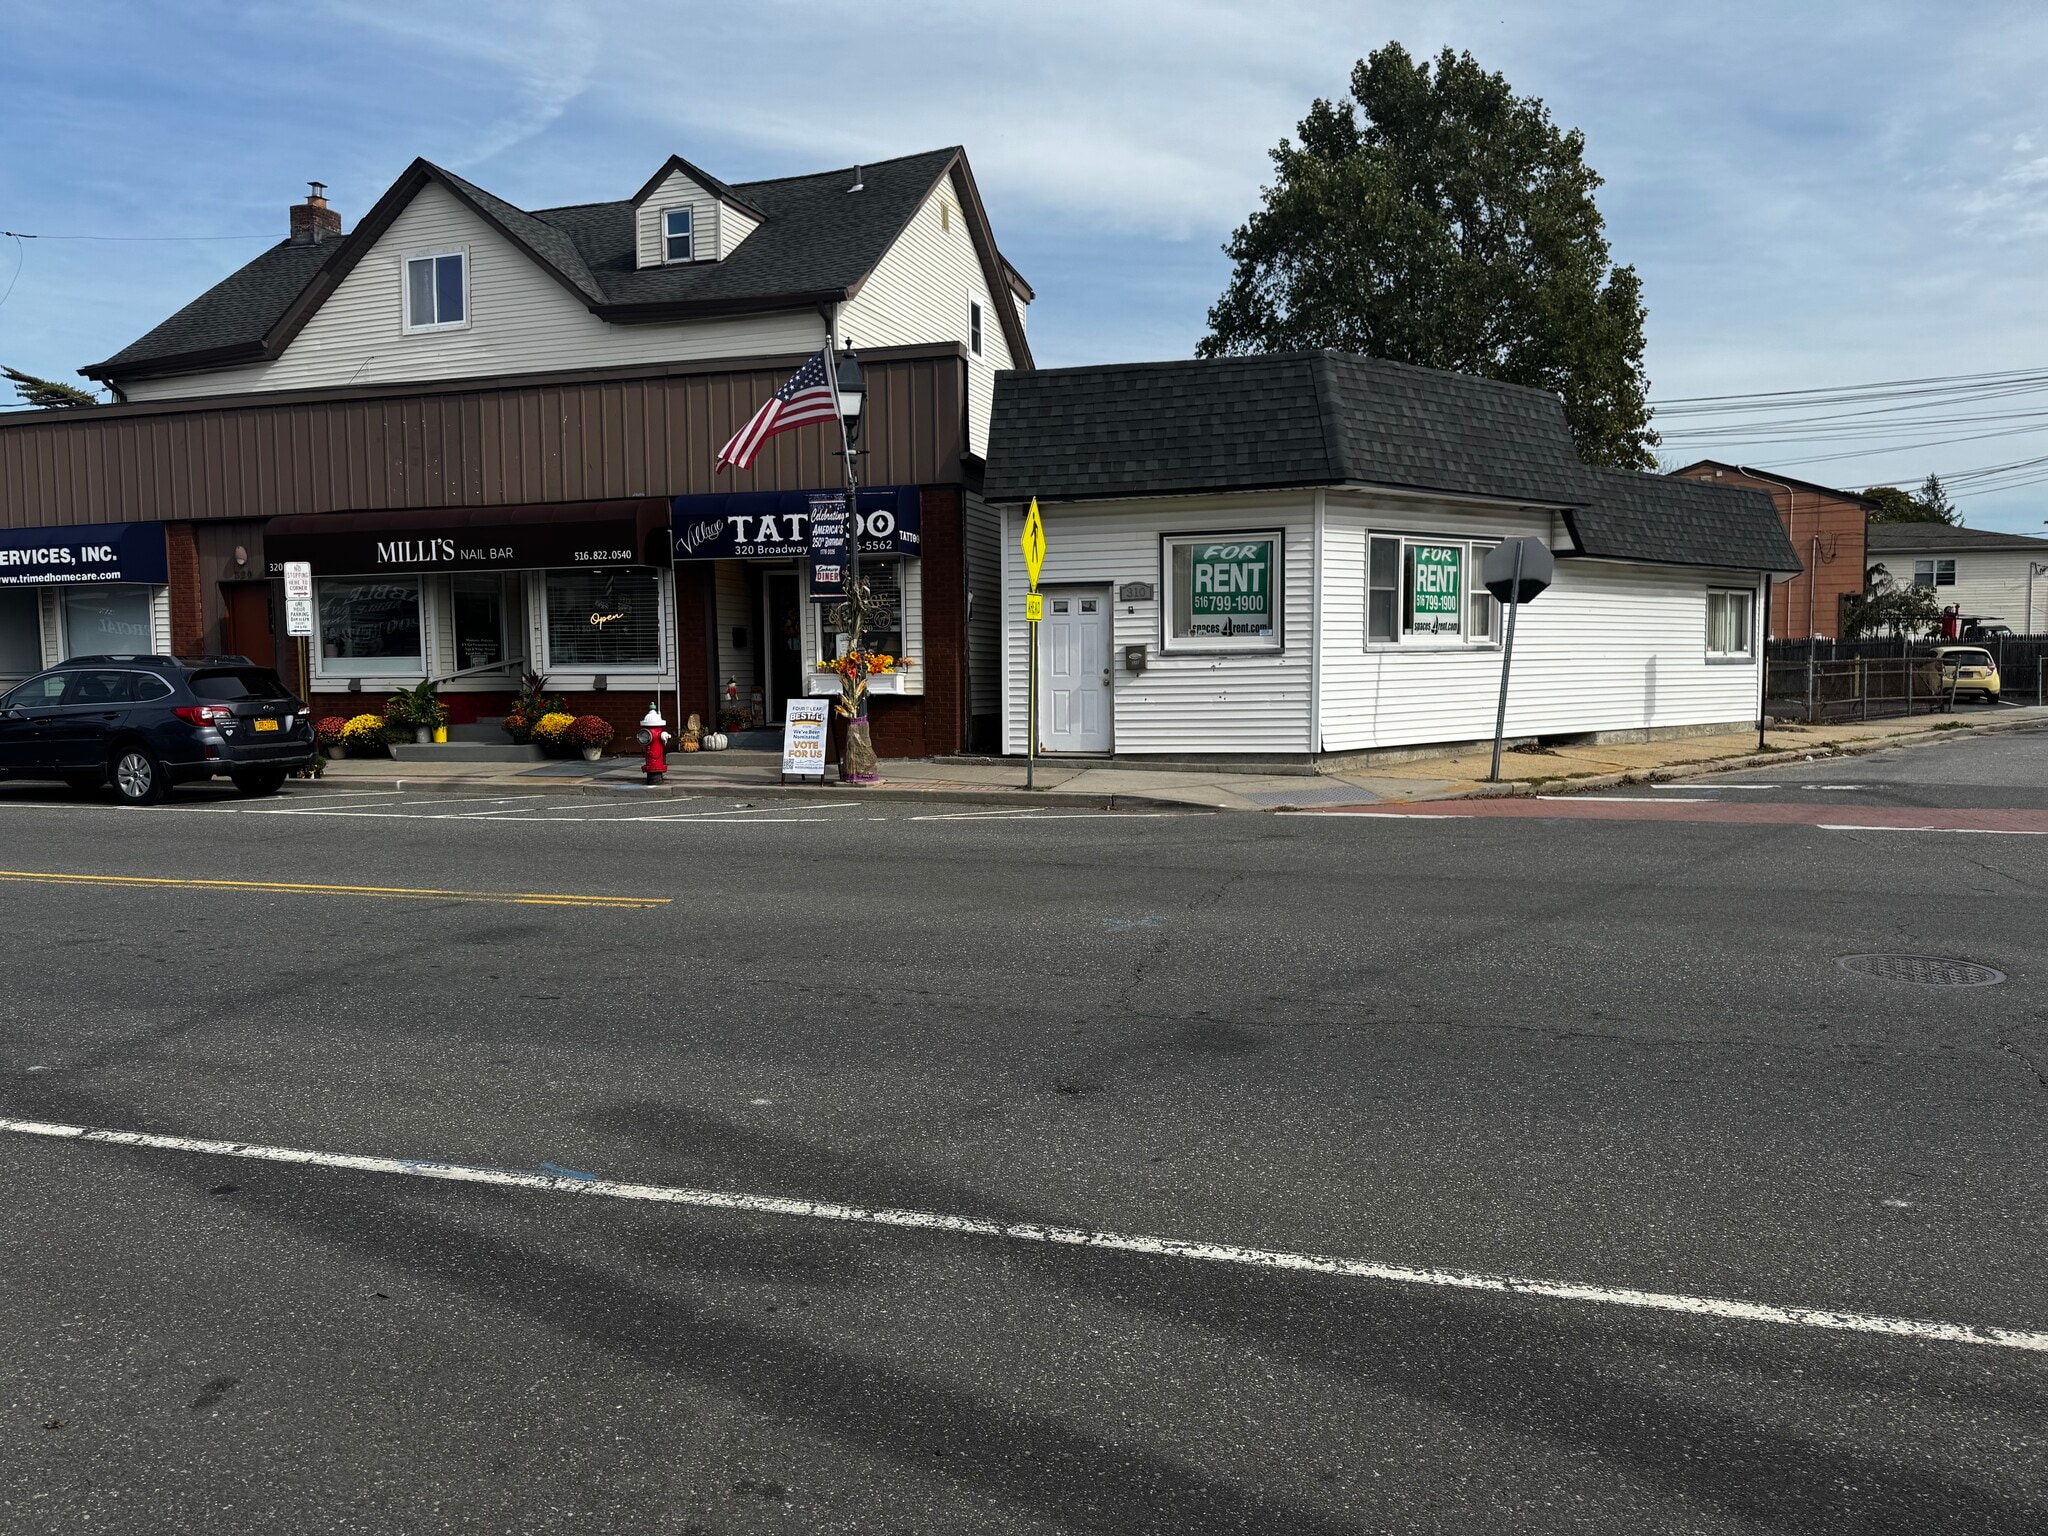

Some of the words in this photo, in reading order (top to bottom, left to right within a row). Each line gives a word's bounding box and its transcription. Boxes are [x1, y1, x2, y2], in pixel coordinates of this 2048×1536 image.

[811, 508, 844, 524] Celebrating
[676, 518, 724, 554] Village
[812, 524, 844, 536] AMERICA'S
[82, 546, 117, 562] INC.
[376, 538, 455, 563] MILLI'S
[460, 549, 486, 560] NAIL
[490, 548, 513, 559] BAR
[574, 550, 632, 560] 516.822.0540
[734, 546, 754, 555] 320
[758, 545, 808, 556] Broadway
[1203, 545, 1259, 560] FOR
[1422, 548, 1452, 561] FOR
[269, 563, 283, 571] 320
[0, 571, 120, 584] ww.trimedhomecare.com
[1195, 562, 1265, 593] RENT
[1417, 564, 1457, 592] RENT
[1126, 588, 1145, 597] 310
[1194, 596, 1208, 608] 516
[1209, 595, 1263, 612] 799-1900
[1417, 595, 1425, 606] 516
[1425, 595, 1456, 610] 799-1900
[590, 612, 624, 630] Open
[793, 741, 819, 749] VOTE
